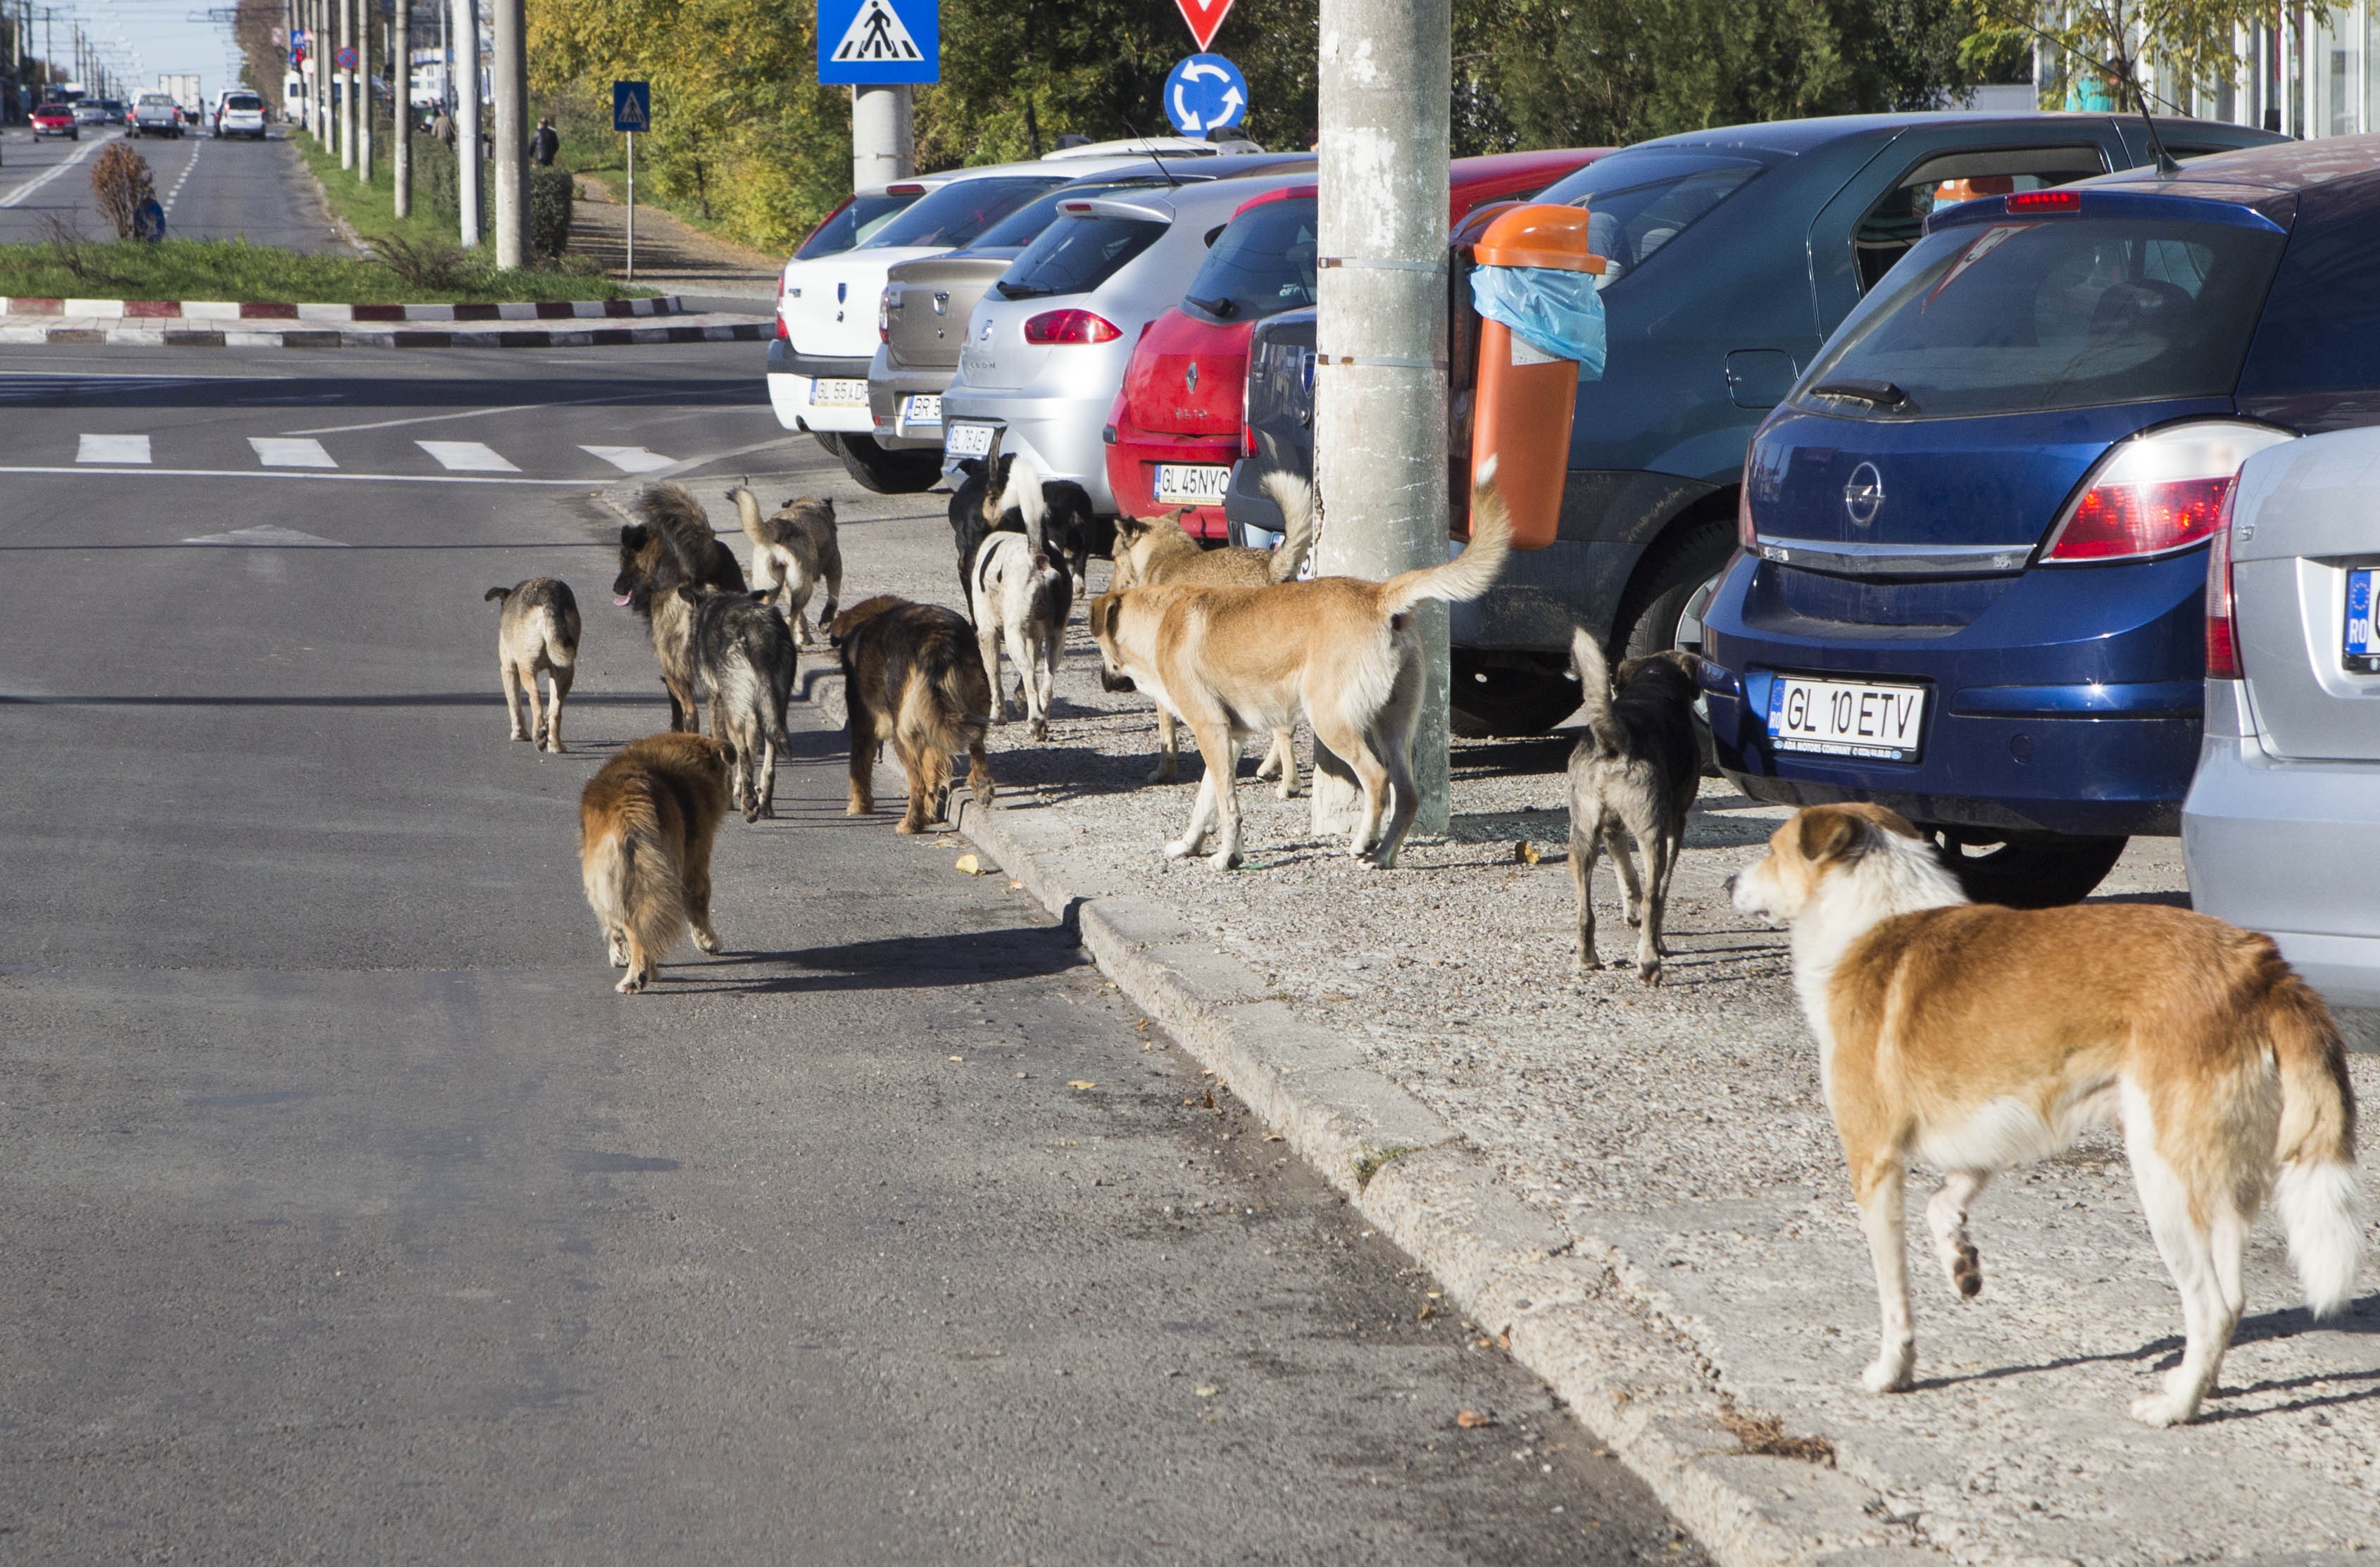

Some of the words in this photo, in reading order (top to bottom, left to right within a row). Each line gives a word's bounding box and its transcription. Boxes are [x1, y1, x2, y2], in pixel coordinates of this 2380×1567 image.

[817, 382, 828, 398] GL
[913, 398, 930, 416] BR
[1175, 408, 1208, 418] CLIO
[1163, 468, 1177, 492] GL
[2349, 619, 2368, 643] RO
[1788, 688, 1816, 731] GL
[1770, 711, 1781, 729] RO
